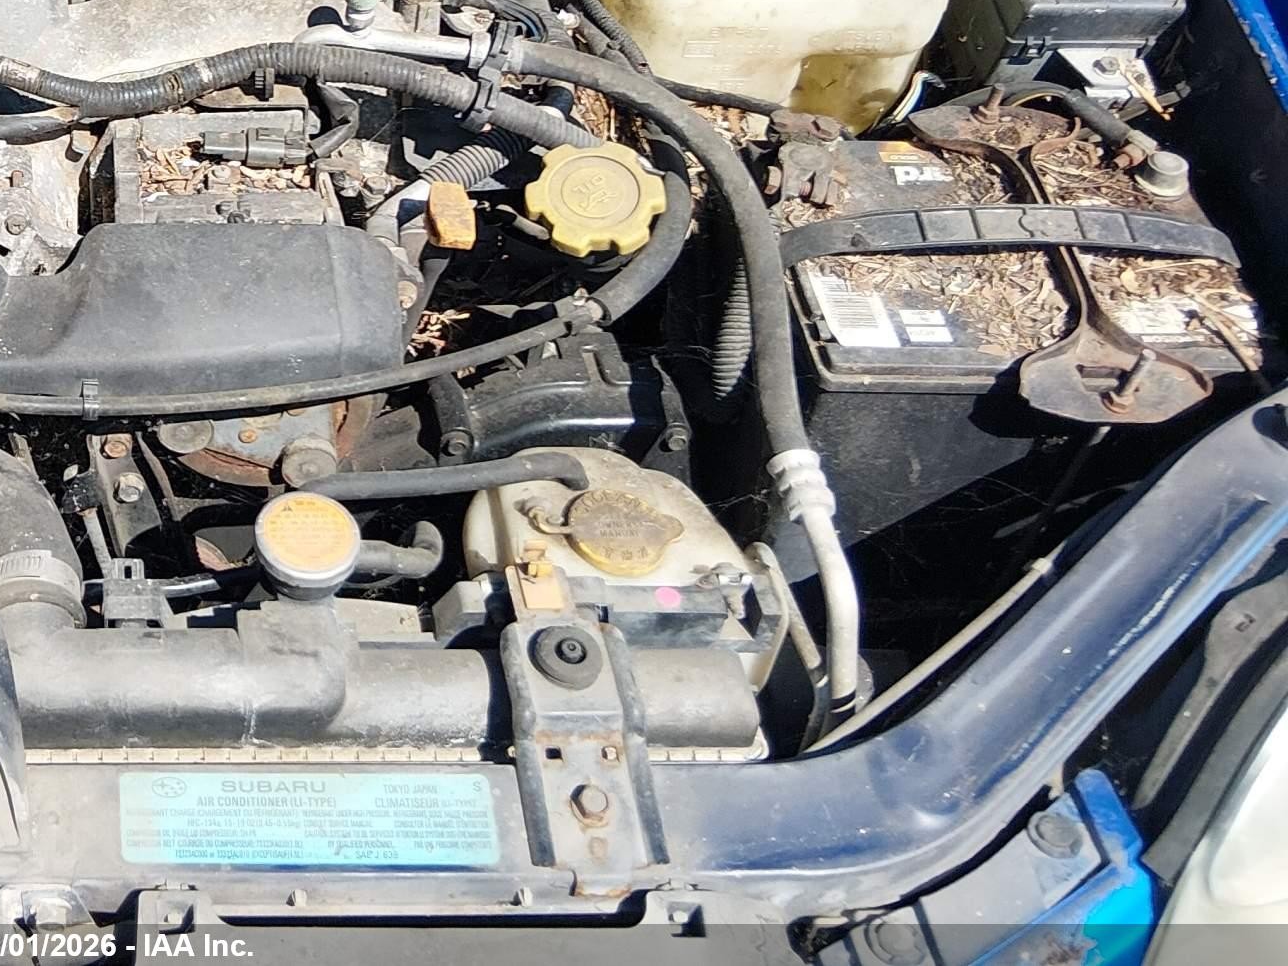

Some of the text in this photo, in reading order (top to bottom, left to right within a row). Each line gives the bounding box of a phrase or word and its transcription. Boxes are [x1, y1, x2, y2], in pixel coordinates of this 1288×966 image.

[221, 780, 327, 794] SUBARU
[383, 785, 438, 794] TOKYO JAPAN
[196, 796, 215, 807] AIR
[217, 796, 288, 807] CONDITIONER
[374, 797, 440, 809] CLIMATISEUR
